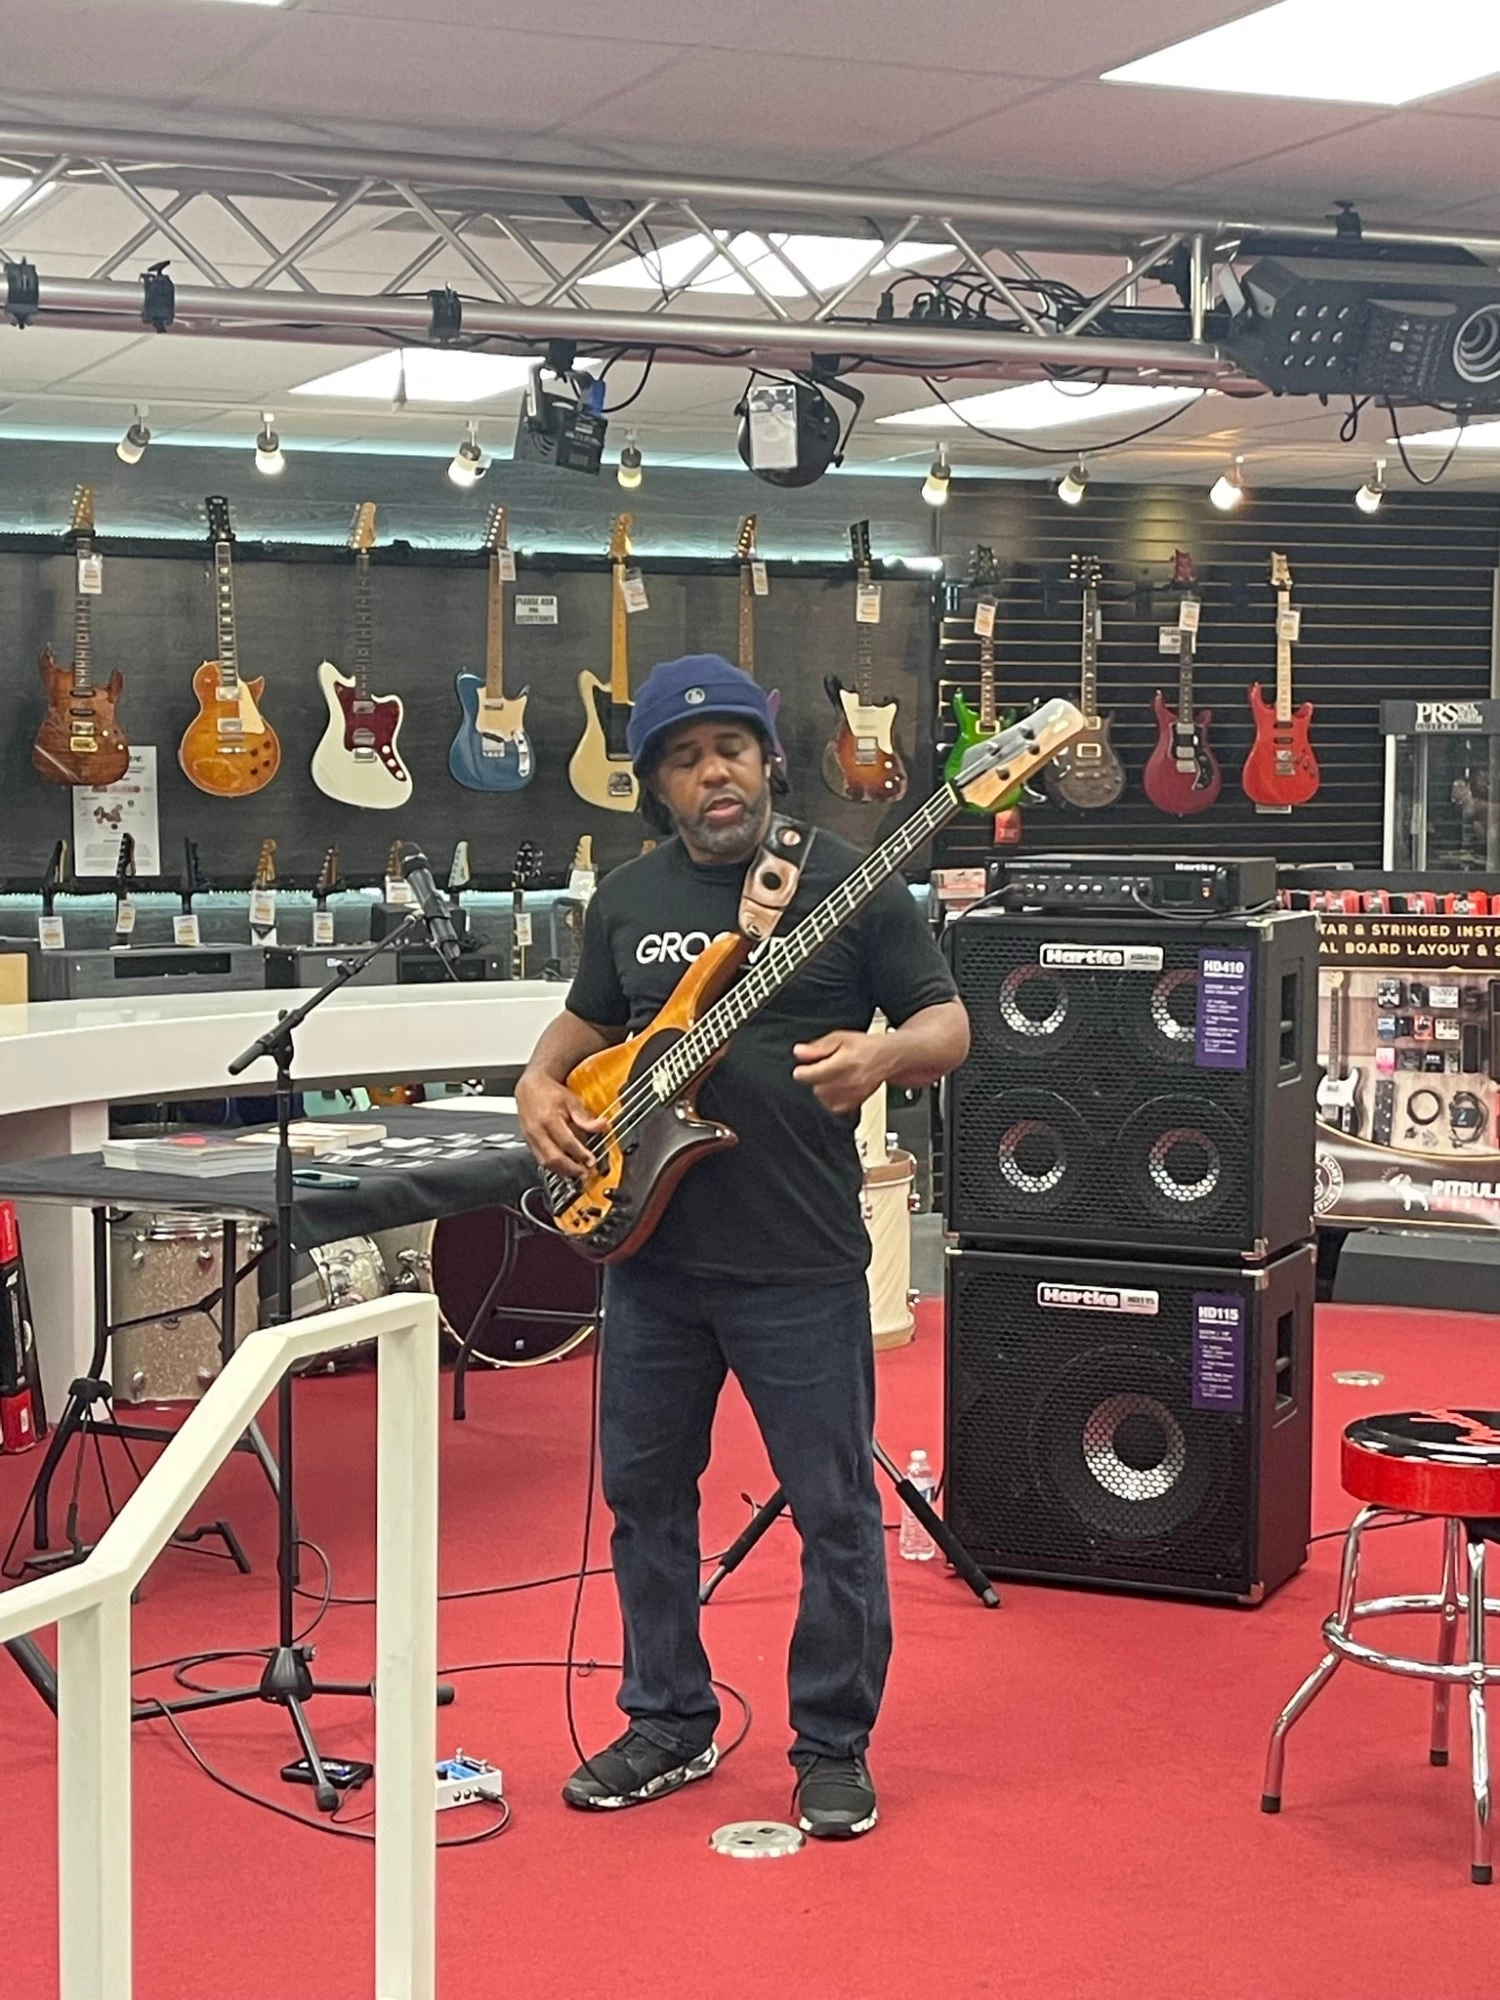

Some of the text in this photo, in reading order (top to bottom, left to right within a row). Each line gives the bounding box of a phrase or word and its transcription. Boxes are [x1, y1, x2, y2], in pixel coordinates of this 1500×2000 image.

[1416, 702, 1459, 724] PRS
[1371, 924, 1450, 937] STRINGED
[1046, 949, 1122, 965] Hartke
[1345, 943, 1400, 955] BOARD
[1407, 944, 1470, 956] LAYOUT
[1204, 960, 1245, 974] HD410
[1043, 1288, 1118, 1307] Hartke
[1198, 1306, 1239, 1321] HD115
